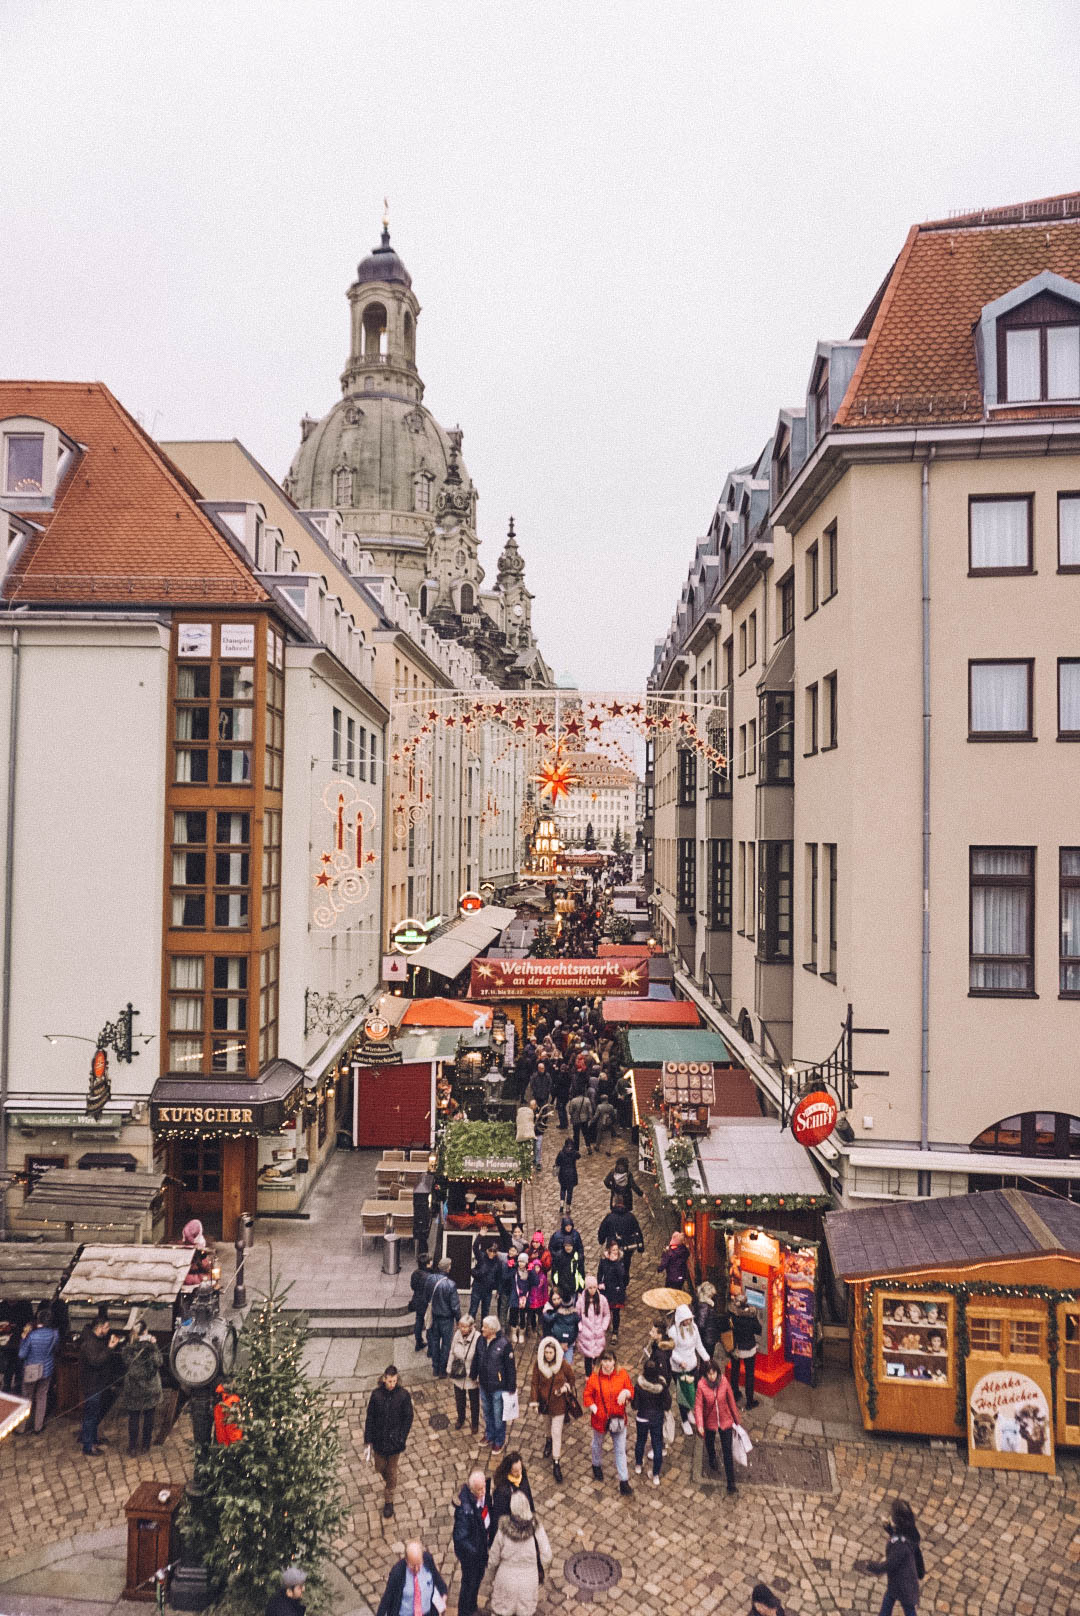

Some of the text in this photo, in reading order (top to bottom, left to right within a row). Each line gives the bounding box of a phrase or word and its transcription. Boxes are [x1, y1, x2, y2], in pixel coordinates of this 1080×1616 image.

[500, 961, 620, 975] Weihnachtsmarkt
[527, 976, 543, 985] der
[546, 976, 607, 986] Frauenkirche
[158, 1107, 253, 1123] KUTSCHER
